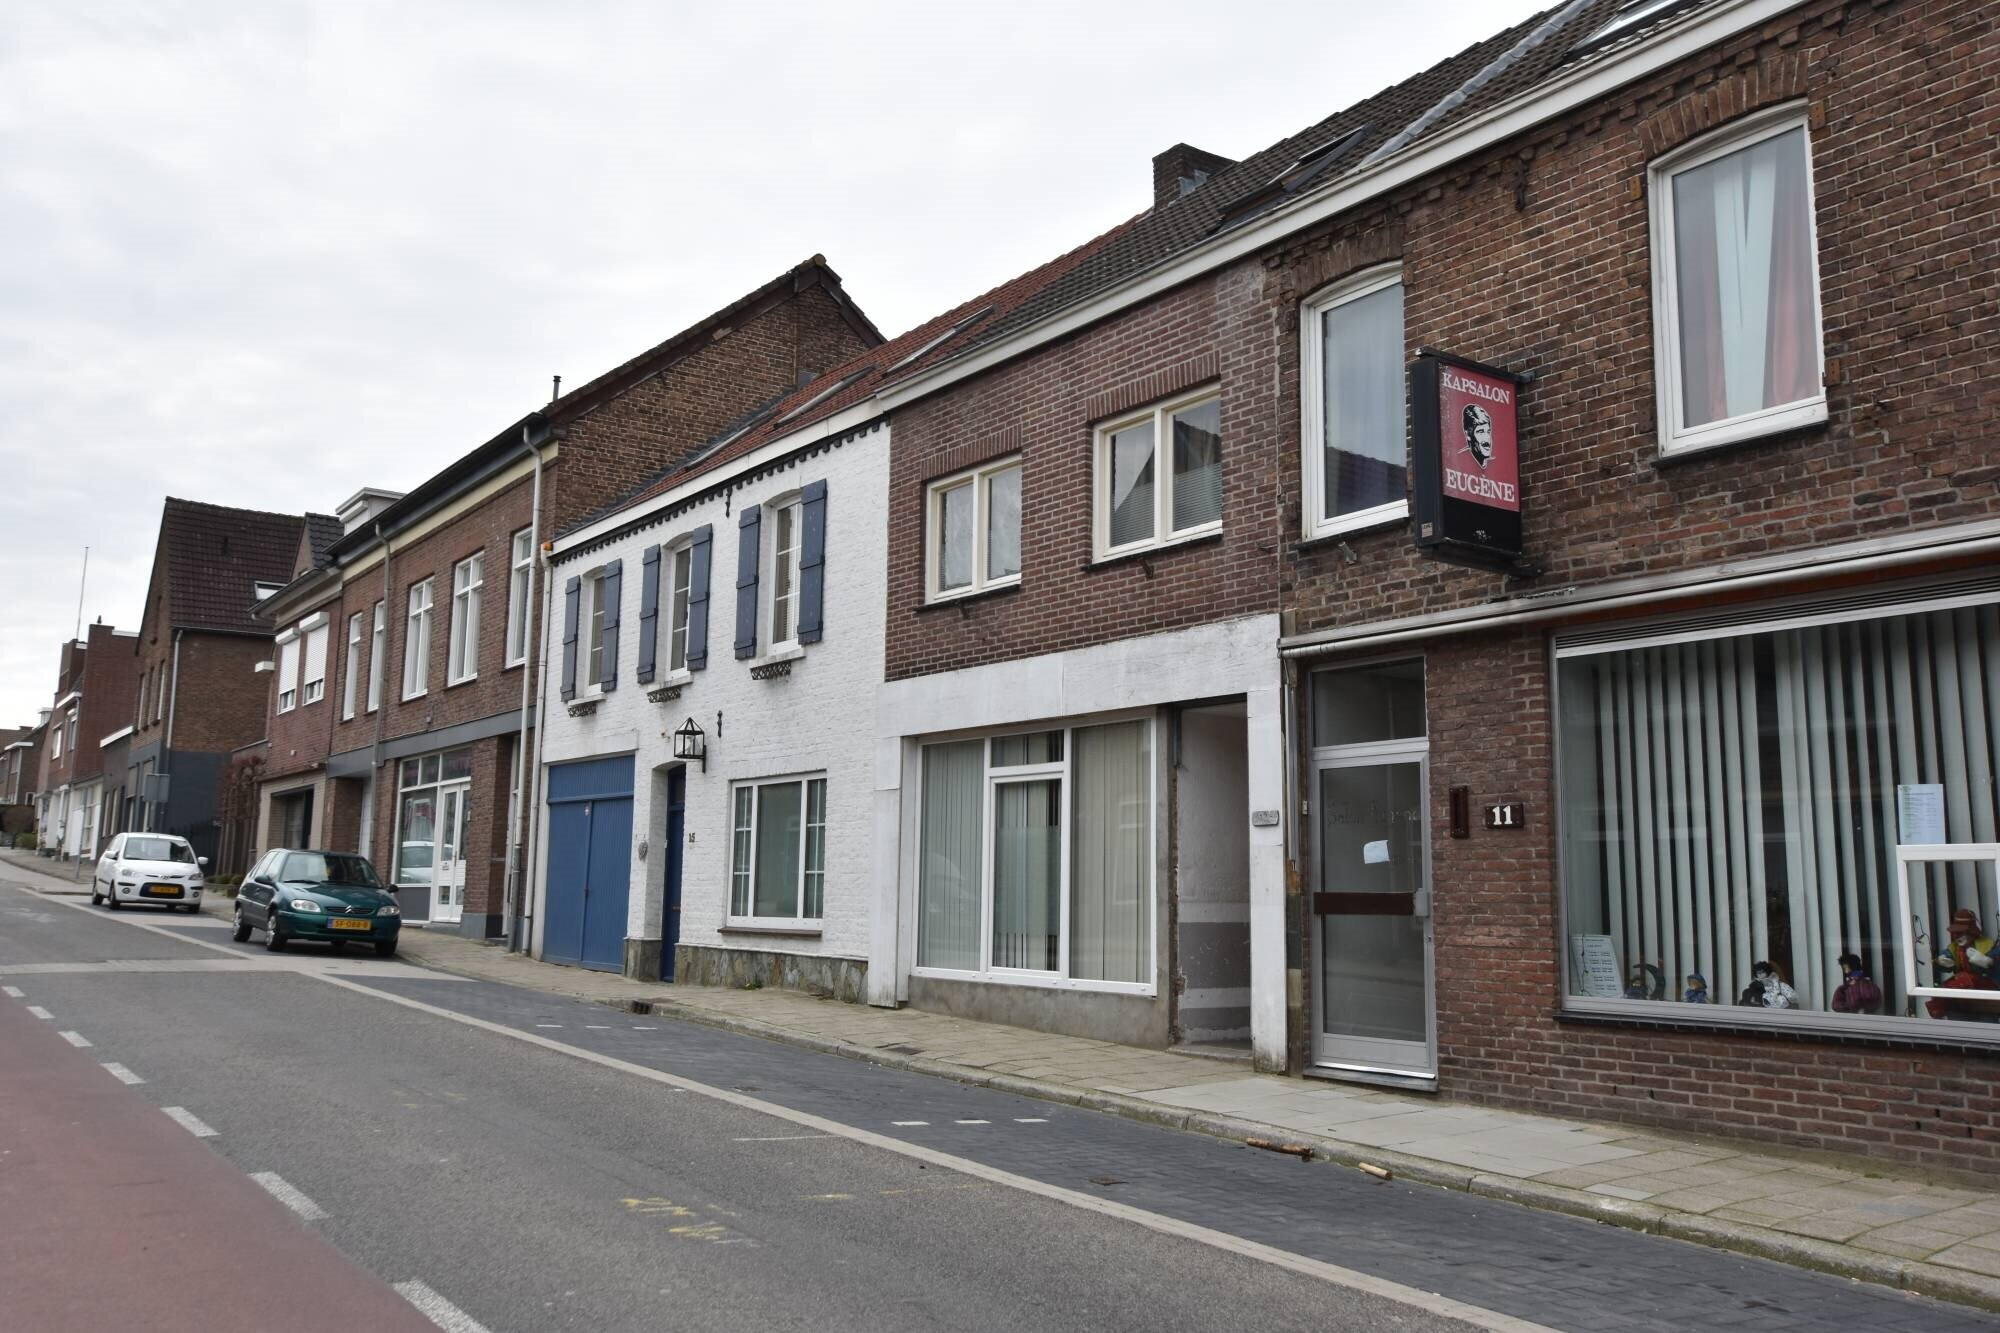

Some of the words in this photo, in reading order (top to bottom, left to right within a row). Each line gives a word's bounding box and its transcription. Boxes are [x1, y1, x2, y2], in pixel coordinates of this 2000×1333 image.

[1441, 371, 1510, 405] KAPSALON
[1445, 467, 1515, 502] EUGÈNE
[1492, 805, 1513, 825] 11
